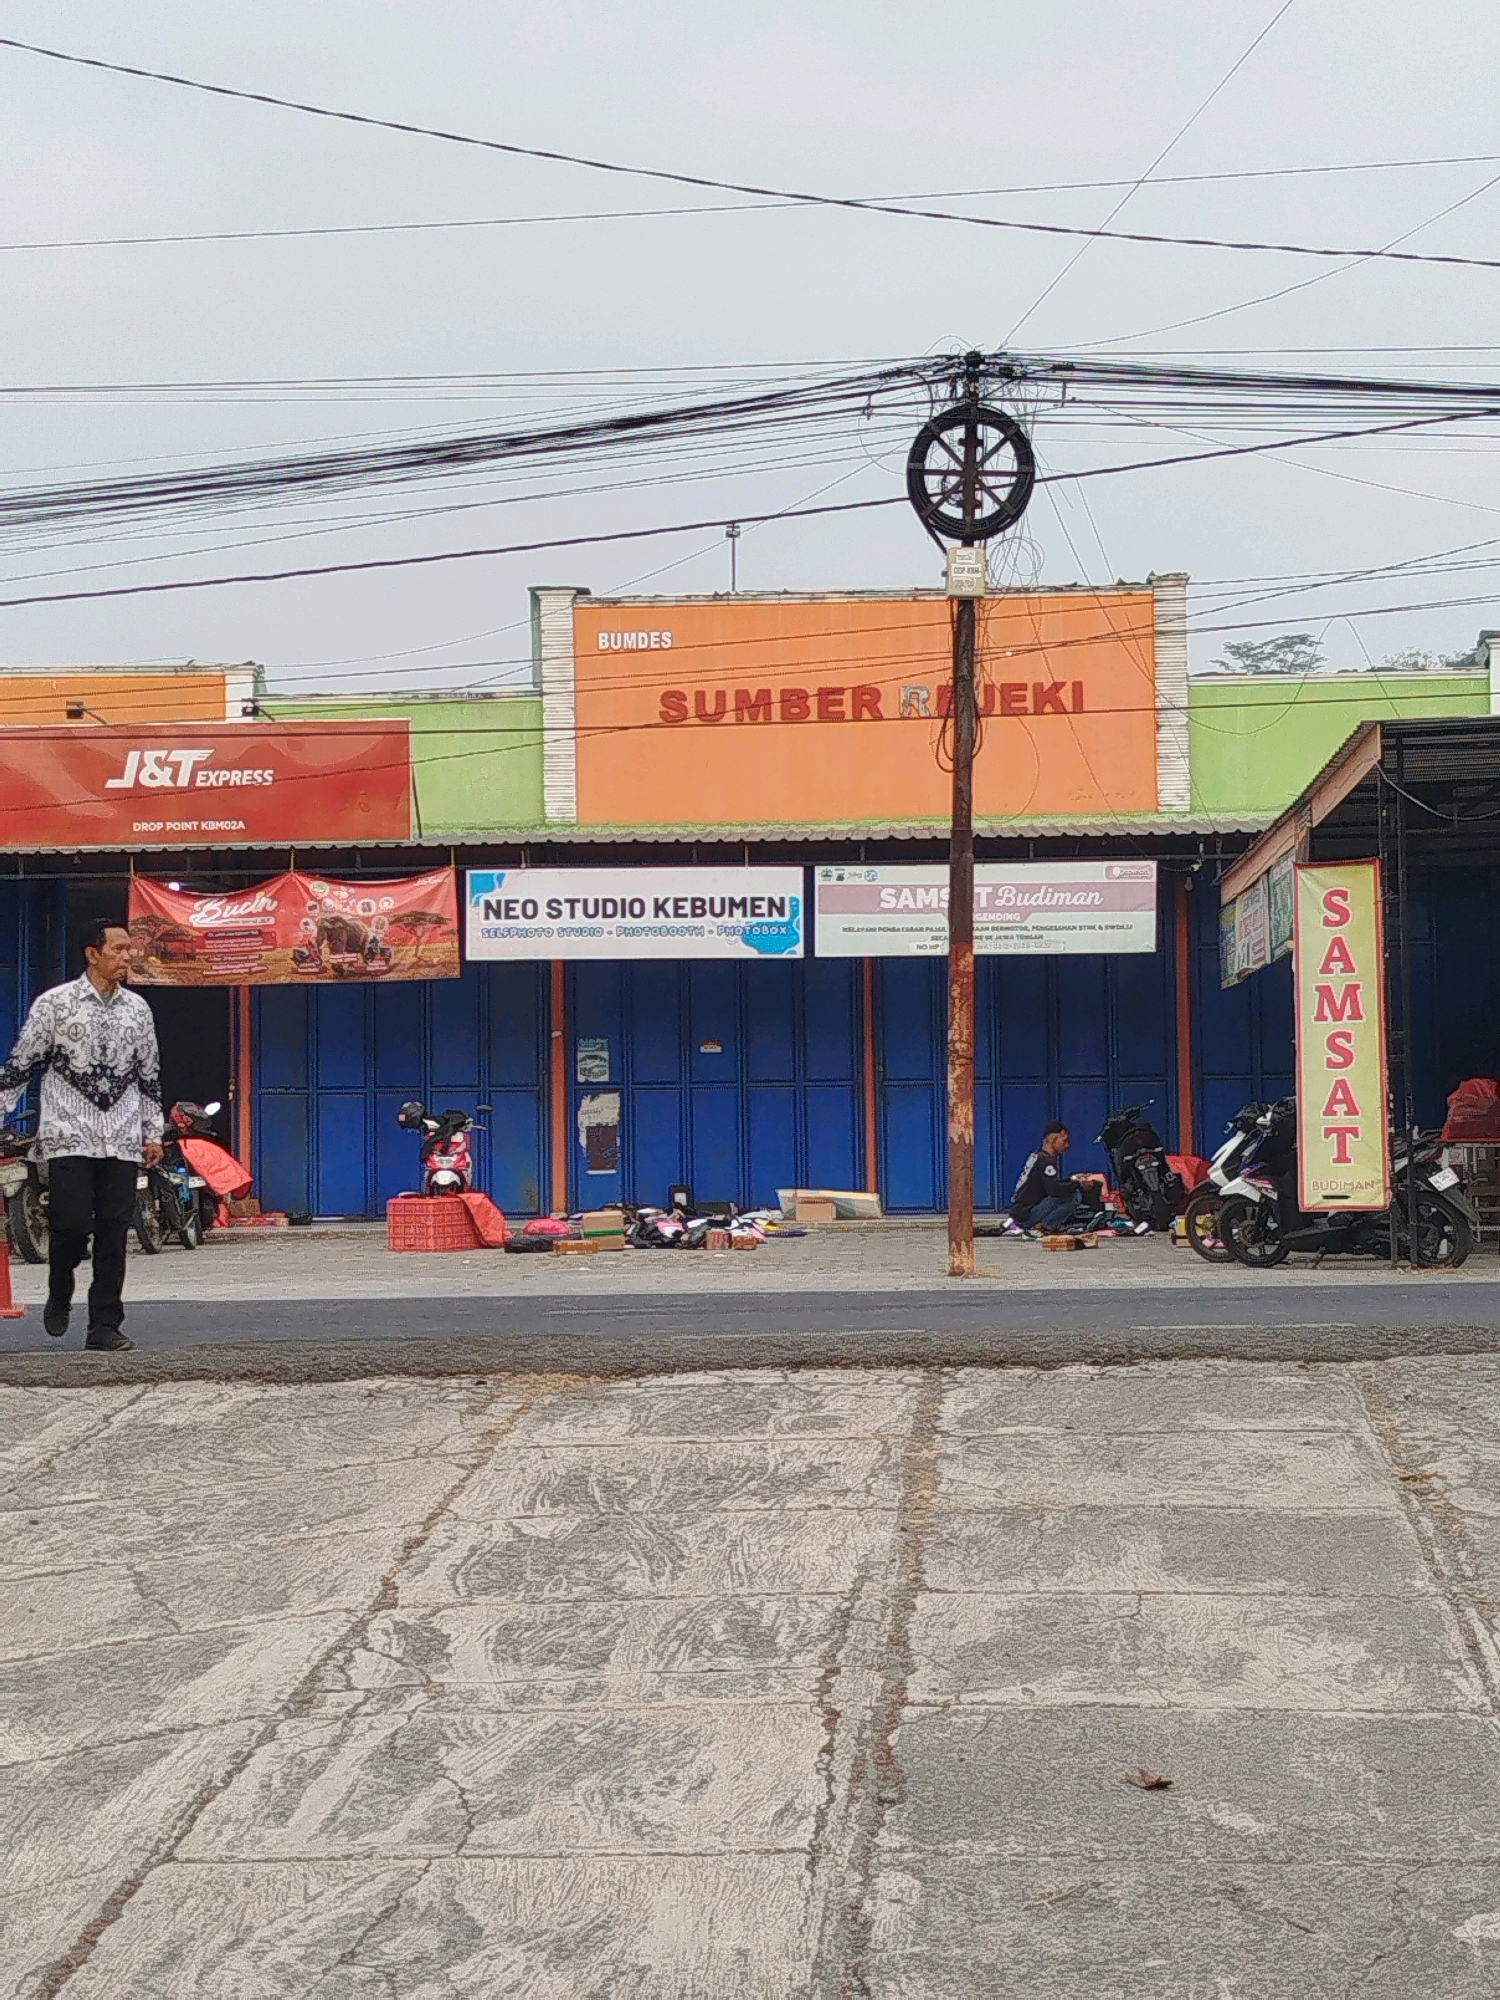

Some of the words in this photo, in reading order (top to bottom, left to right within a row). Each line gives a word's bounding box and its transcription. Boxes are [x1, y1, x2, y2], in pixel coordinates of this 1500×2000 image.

[598, 630, 672, 649] BUMDES
[659, 685, 883, 722] SUMBER
[106, 749, 214, 788] J&T
[195, 769, 274, 788] EXPRESS
[133, 822, 163, 832] DROP
[166, 822, 198, 832] POINT
[201, 821, 246, 831] KBM02A
[483, 898, 539, 921] NEO
[545, 897, 646, 920] STUDIO
[653, 896, 786, 918] KEBUMEN
[880, 887, 992, 909] SAMST
[995, 886, 1104, 907] Budiman
[557, 926, 603, 938] STUDIO
[615, 925, 705, 938] PHOTOBOOTH
[716, 925, 788, 937] PHOTOBOX
[1313, 887, 1364, 1164] SAMSAT
[1312, 1181, 1375, 1191] BUDIMAN
